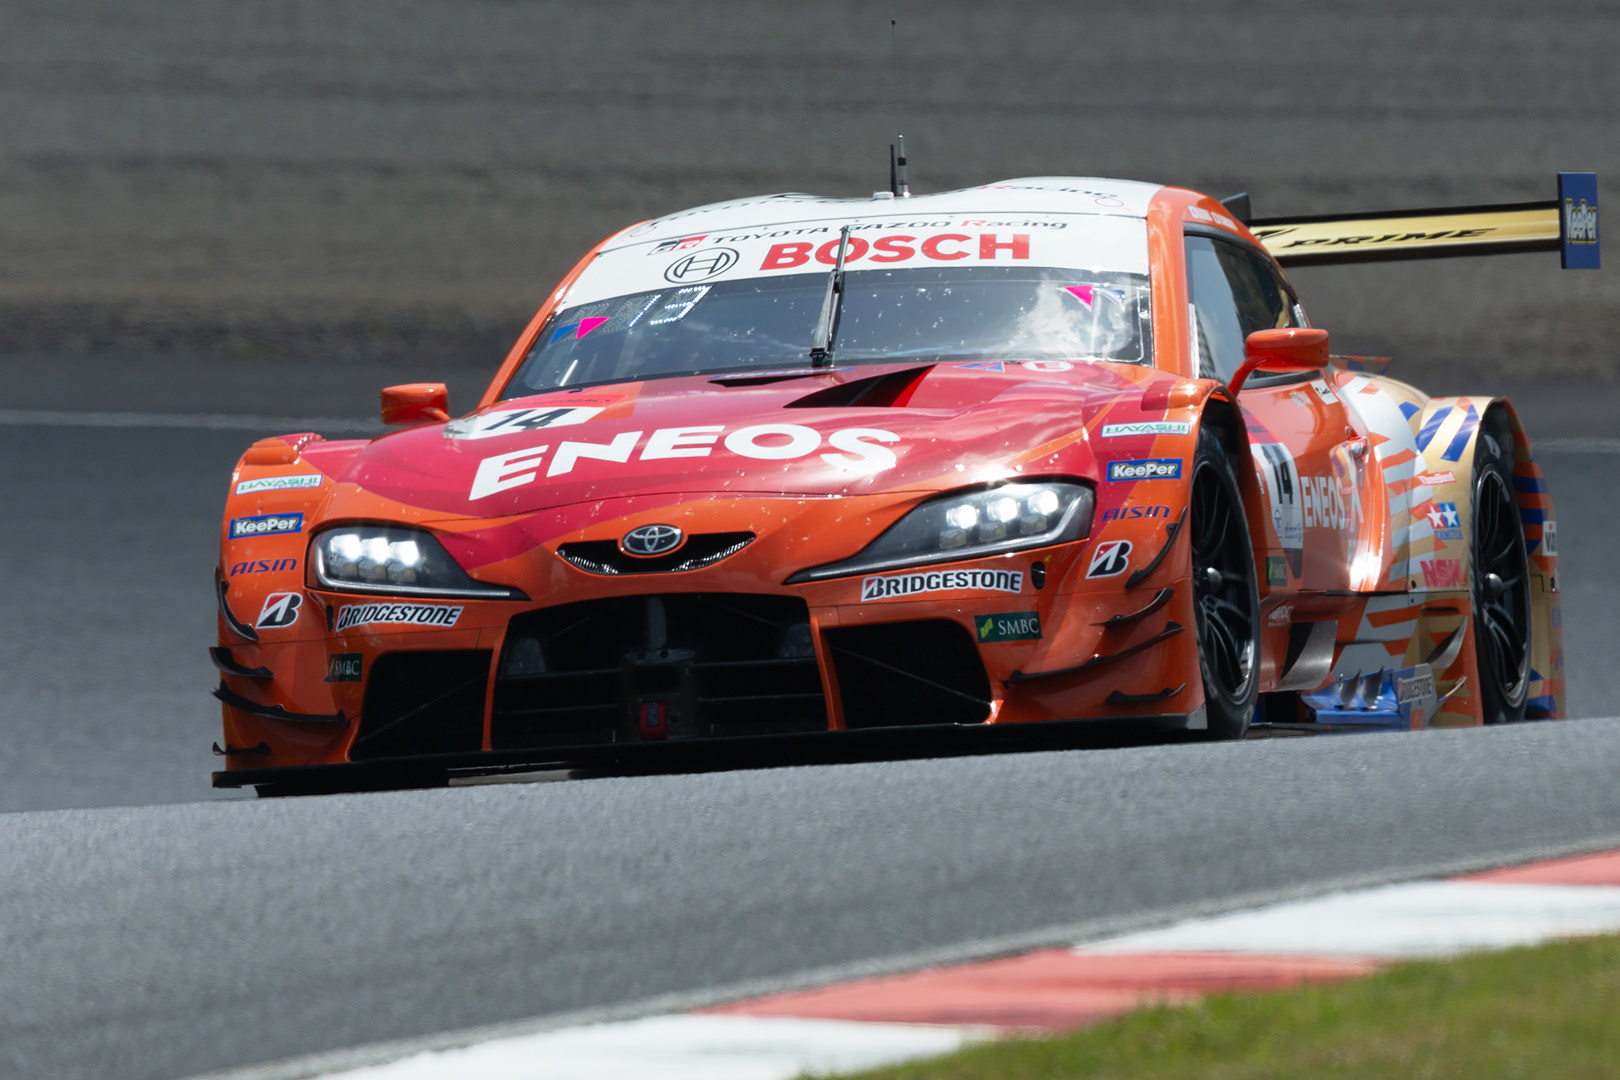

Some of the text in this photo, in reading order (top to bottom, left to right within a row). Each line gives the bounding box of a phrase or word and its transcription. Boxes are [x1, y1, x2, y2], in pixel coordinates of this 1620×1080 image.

[713, 226, 829, 245] TOYOTA
[848, 219, 951, 232] GAZOO
[960, 218, 1068, 231] Racing
[1566, 198, 1597, 243] KeePer
[1280, 228, 1497, 249] PRIME
[759, 233, 1031, 272] BOSCH
[481, 407, 578, 432] 14
[1105, 423, 1187, 434] HAYASHI
[468, 423, 901, 502] ENEOS
[1112, 462, 1178, 479] KeePer
[240, 477, 318, 491] HAYASHI
[1261, 445, 1294, 505] 14
[1102, 505, 1170, 521] AISIN
[1300, 475, 1346, 530] ENEOS
[234, 517, 298, 535] KeePer
[230, 558, 297, 577] AISIN
[862, 570, 1022, 600] BRIDGESTONE
[336, 603, 462, 631] BRIDGESTONE
[998, 618, 1039, 636] SMBC
[334, 659, 360, 676] SMBC
